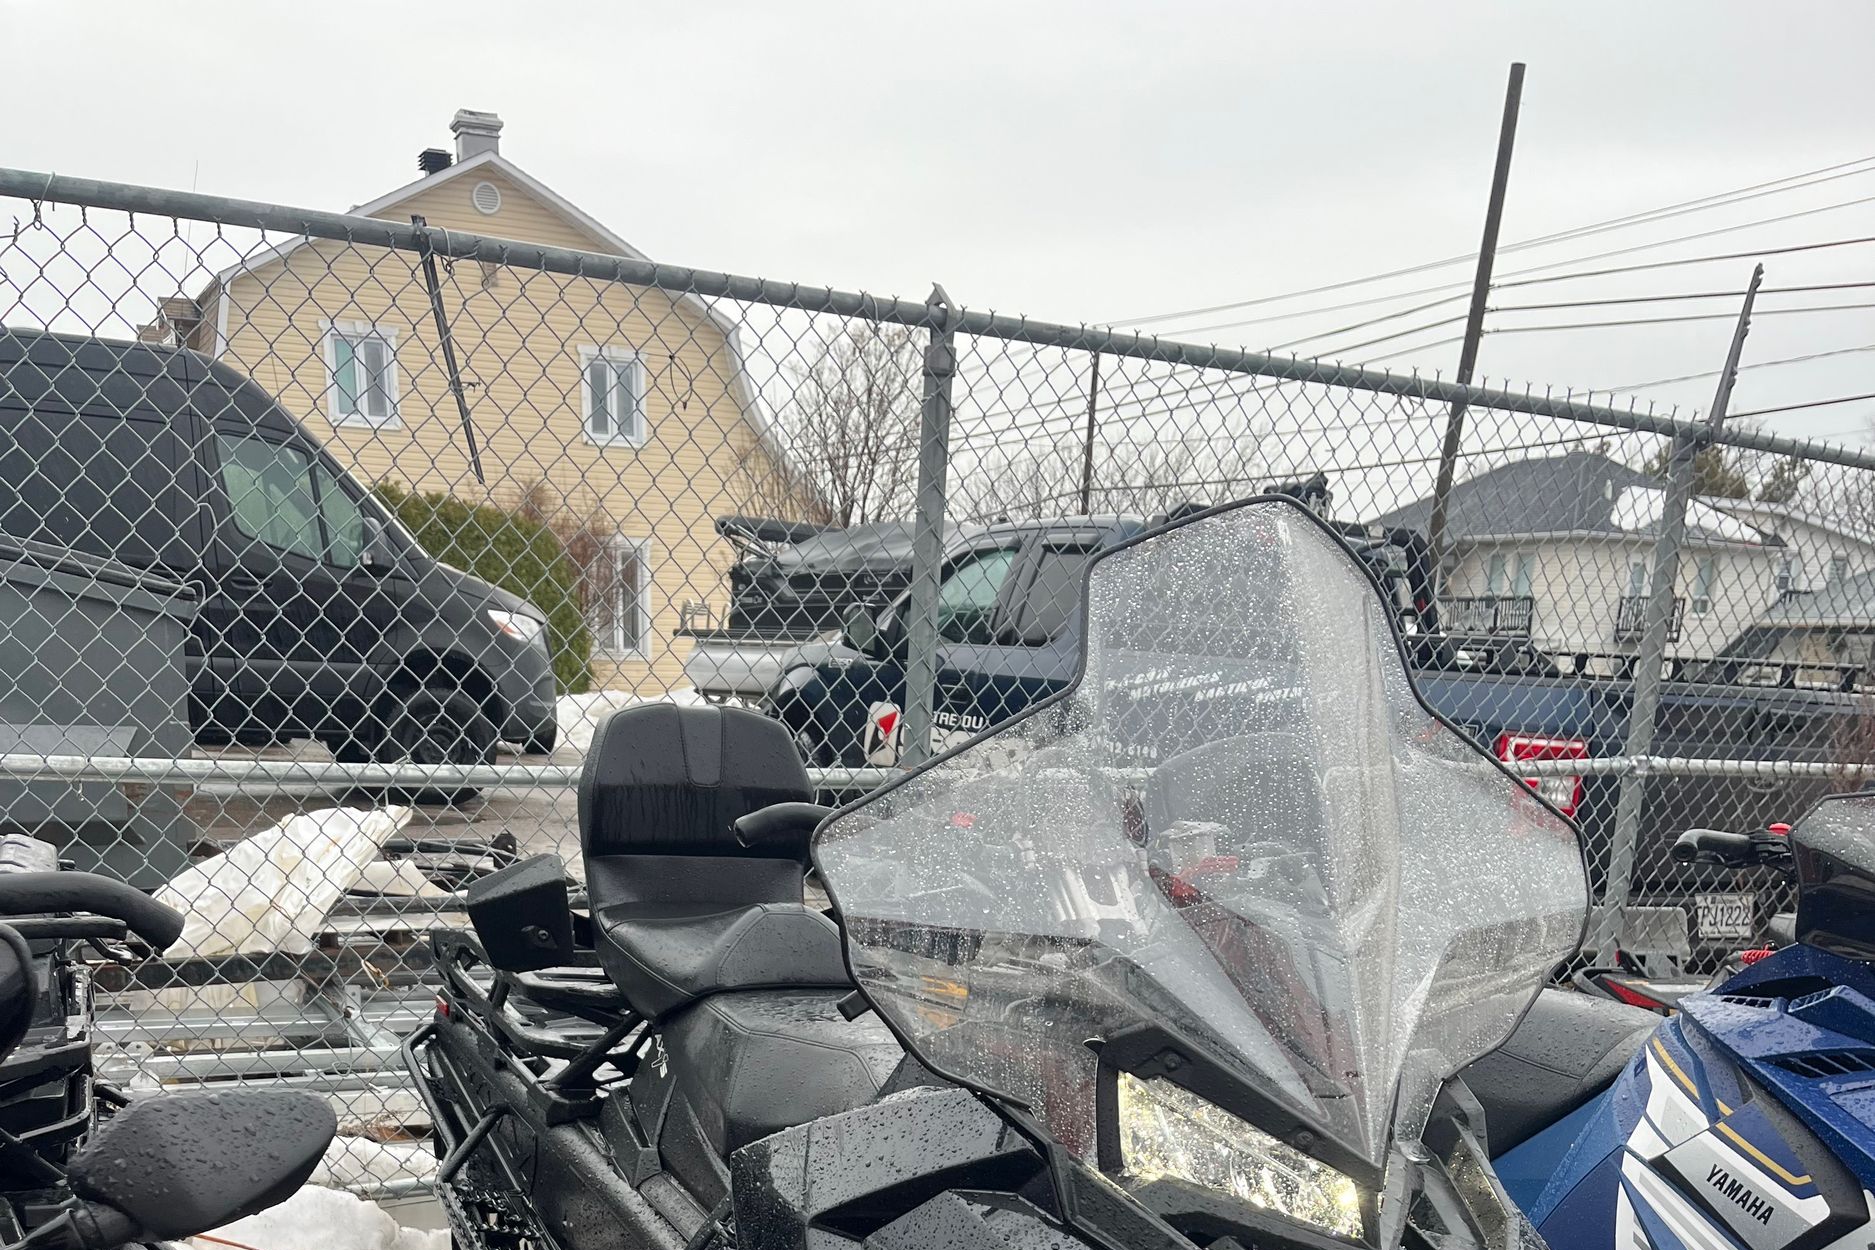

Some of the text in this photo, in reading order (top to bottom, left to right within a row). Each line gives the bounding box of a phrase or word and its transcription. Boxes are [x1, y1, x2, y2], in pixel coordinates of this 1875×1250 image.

[933, 711, 984, 729] TRE DU
[1706, 1163, 1775, 1226] YAMAHA
